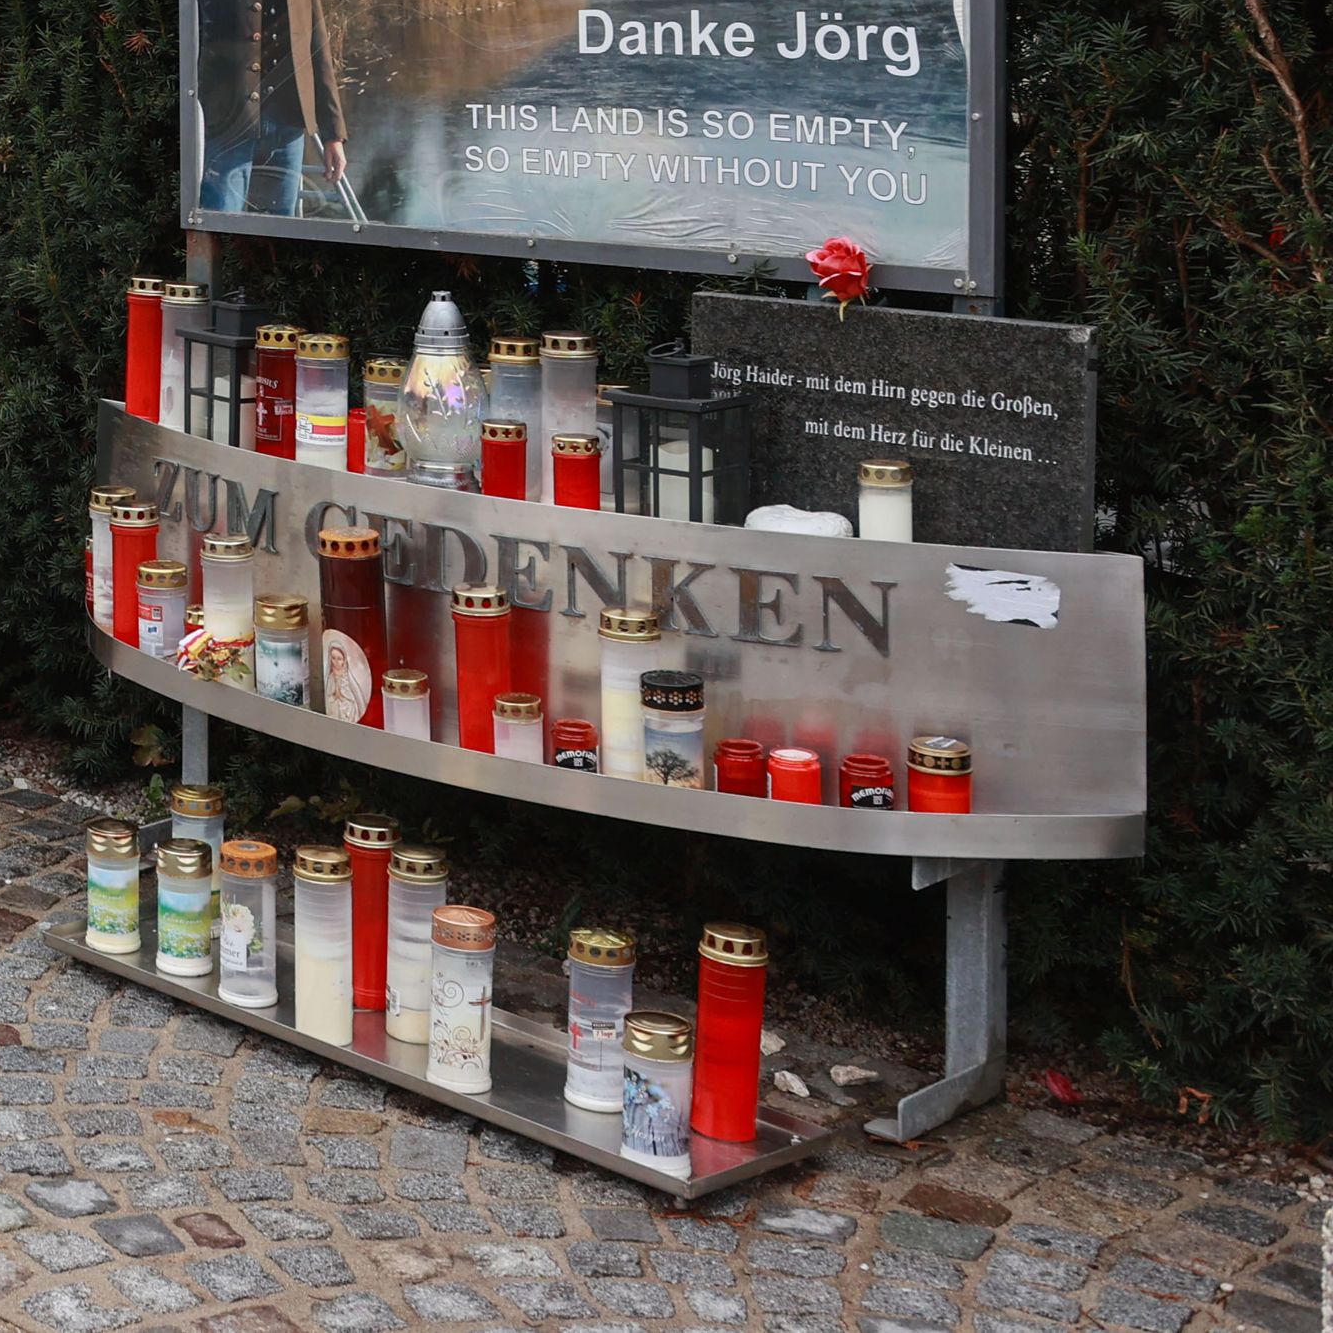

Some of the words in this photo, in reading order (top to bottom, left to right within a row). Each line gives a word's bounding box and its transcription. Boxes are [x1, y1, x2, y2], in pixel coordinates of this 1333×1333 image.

[577, 9, 756, 58] Danke
[776, 11, 921, 78] Jörg
[465, 103, 539, 132] THIS
[550, 106, 644, 136] LAND
[657, 108, 689, 138] IS
[702, 110, 755, 140] SO
[768, 114, 917, 160] EMPTY,
[465, 145, 510, 173] SO
[521, 148, 637, 182] EMPTY
[647, 153, 826, 192] WITHOUT
[836, 163, 929, 206] YOU
[710, 362, 742, 386] Jörg
[746, 365, 795, 387] Haider
[805, 373, 830, 391] mit
[834, 376, 866, 395] dem
[871, 378, 906, 399] Hirn
[910, 387, 956, 408] gegen
[961, 389, 986, 409] die
[991, 391, 1059, 421] Großen,
[805, 418, 829, 436] mit
[834, 420, 866, 440] dem
[870, 423, 906, 446] Herz
[912, 429, 935, 449] für
[940, 433, 964, 453] die
[968, 435, 1033, 462] Kleinen
[152, 456, 279, 555] ZUM
[305, 500, 899, 658] GEDENKEN
